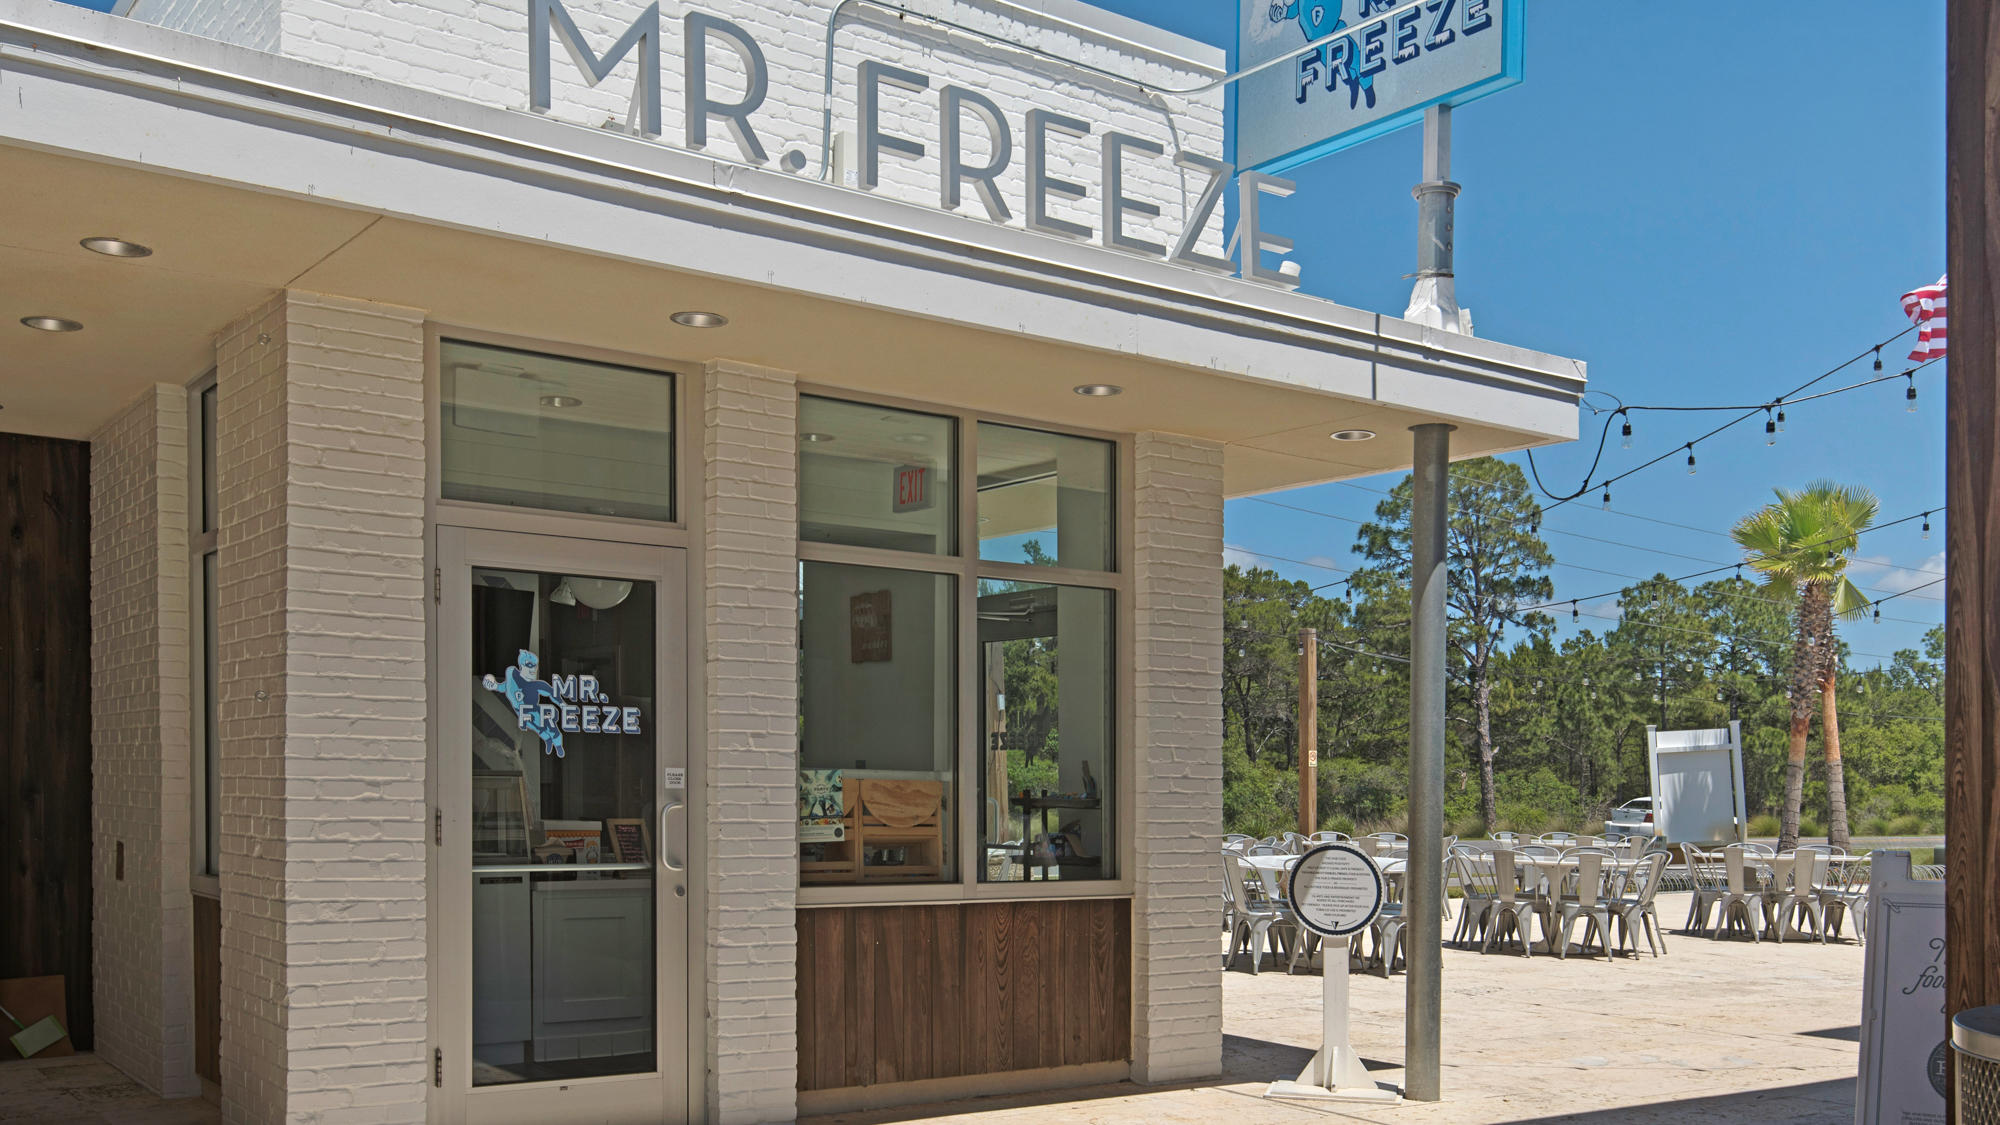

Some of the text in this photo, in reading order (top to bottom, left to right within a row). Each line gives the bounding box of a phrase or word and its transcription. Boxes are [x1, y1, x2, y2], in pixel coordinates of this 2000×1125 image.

[1295, 0, 1493, 105] FREEZE
[527, 0, 1301, 291] MR. FREEZE
[899, 467, 926, 504] EXIT
[551, 673, 609, 703] MR.
[518, 704, 641, 734] FREEZE
[1902, 965, 1946, 995] foo
